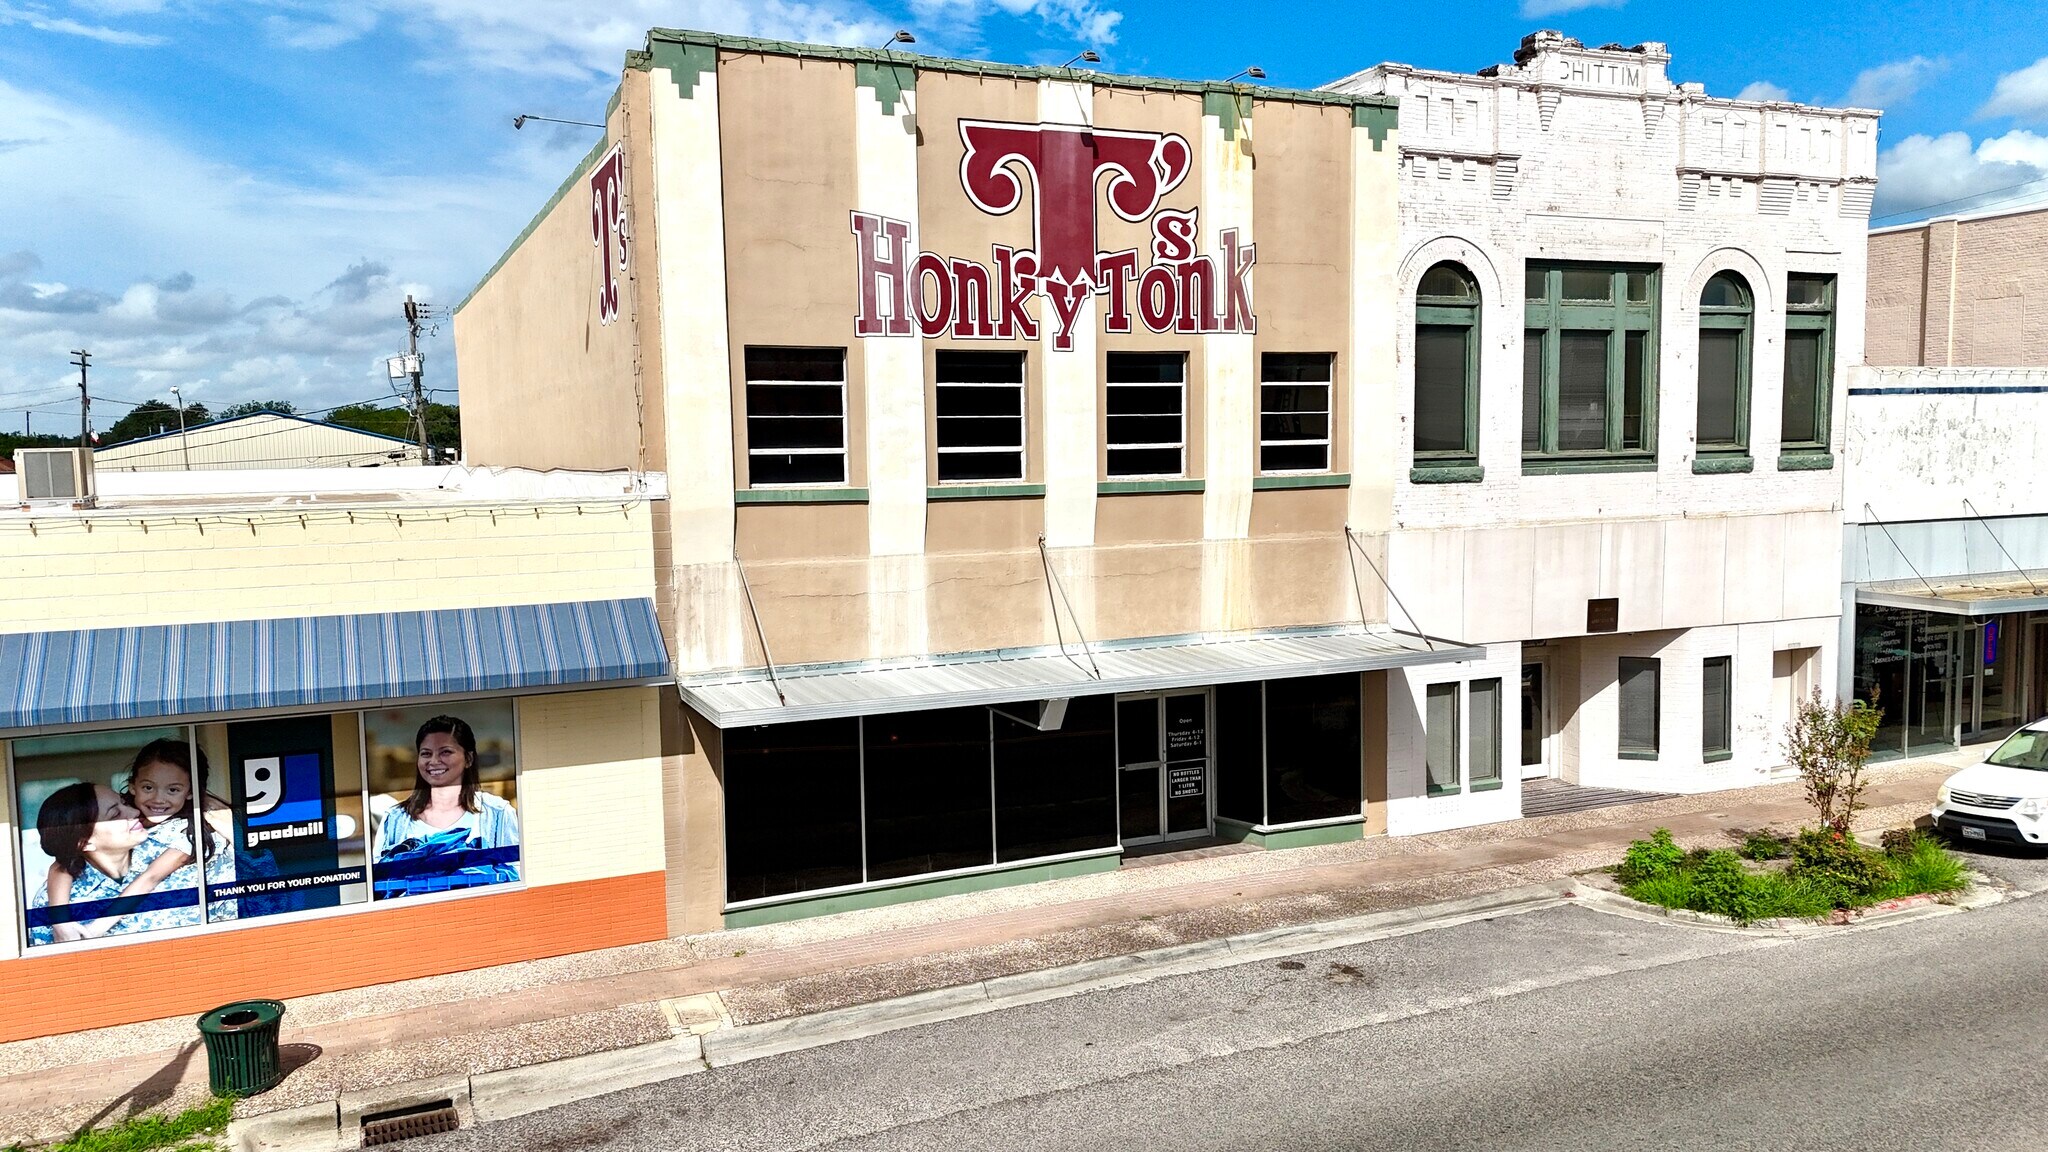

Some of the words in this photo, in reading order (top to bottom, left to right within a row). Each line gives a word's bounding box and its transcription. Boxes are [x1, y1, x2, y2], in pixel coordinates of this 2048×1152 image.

[1560, 60, 1640, 88] CHITTIM
[850, 209, 1091, 352] Honky
[1098, 226, 1257, 335] Tonk
[247, 821, 324, 848] goodwill
[214, 886, 246, 897] THANK
[246, 882, 266, 893] YOU
[267, 880, 286, 890] FOR
[286, 877, 312, 888] YOUR
[313, 871, 361, 884] DONATION!
